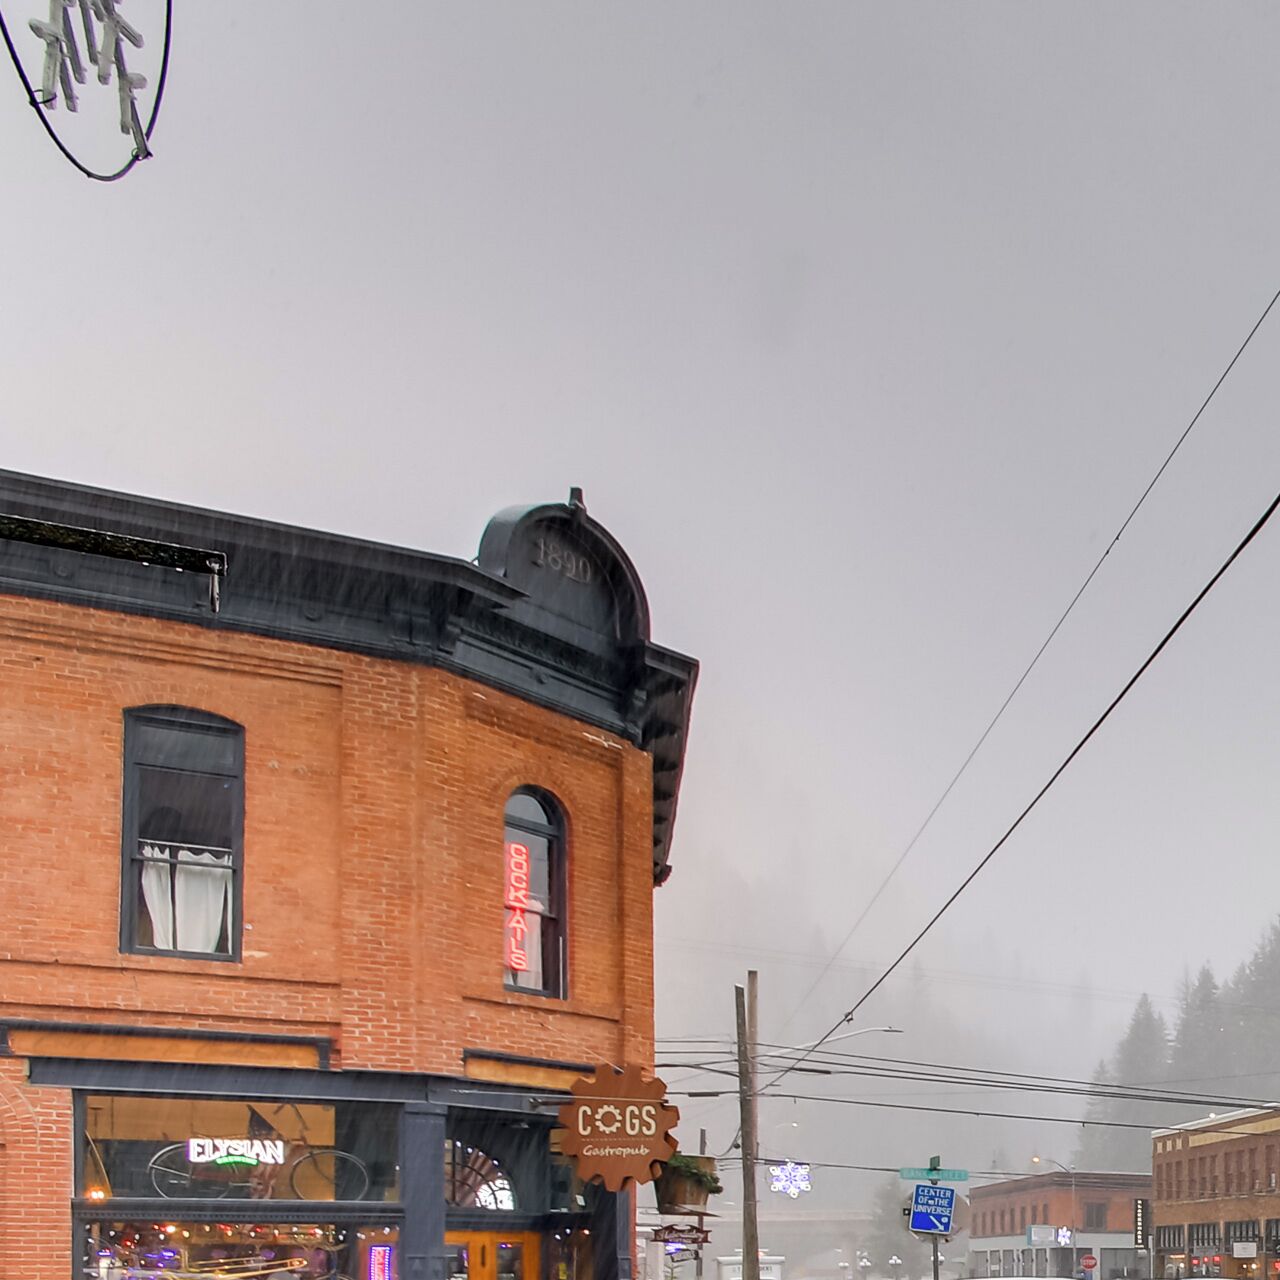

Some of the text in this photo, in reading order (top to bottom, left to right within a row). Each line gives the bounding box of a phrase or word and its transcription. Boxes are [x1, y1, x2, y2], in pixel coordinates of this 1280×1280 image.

[508, 843, 529, 971] COCKTAILS
[578, 1104, 657, 1136] COGS
[189, 1138, 285, 1165] ELYSIAN
[582, 1144, 650, 1158] Gastropub
[918, 1186, 952, 1198] CENTER
[918, 1195, 950, 1207] OF THE
[914, 1204, 952, 1216] UNIVERSE
